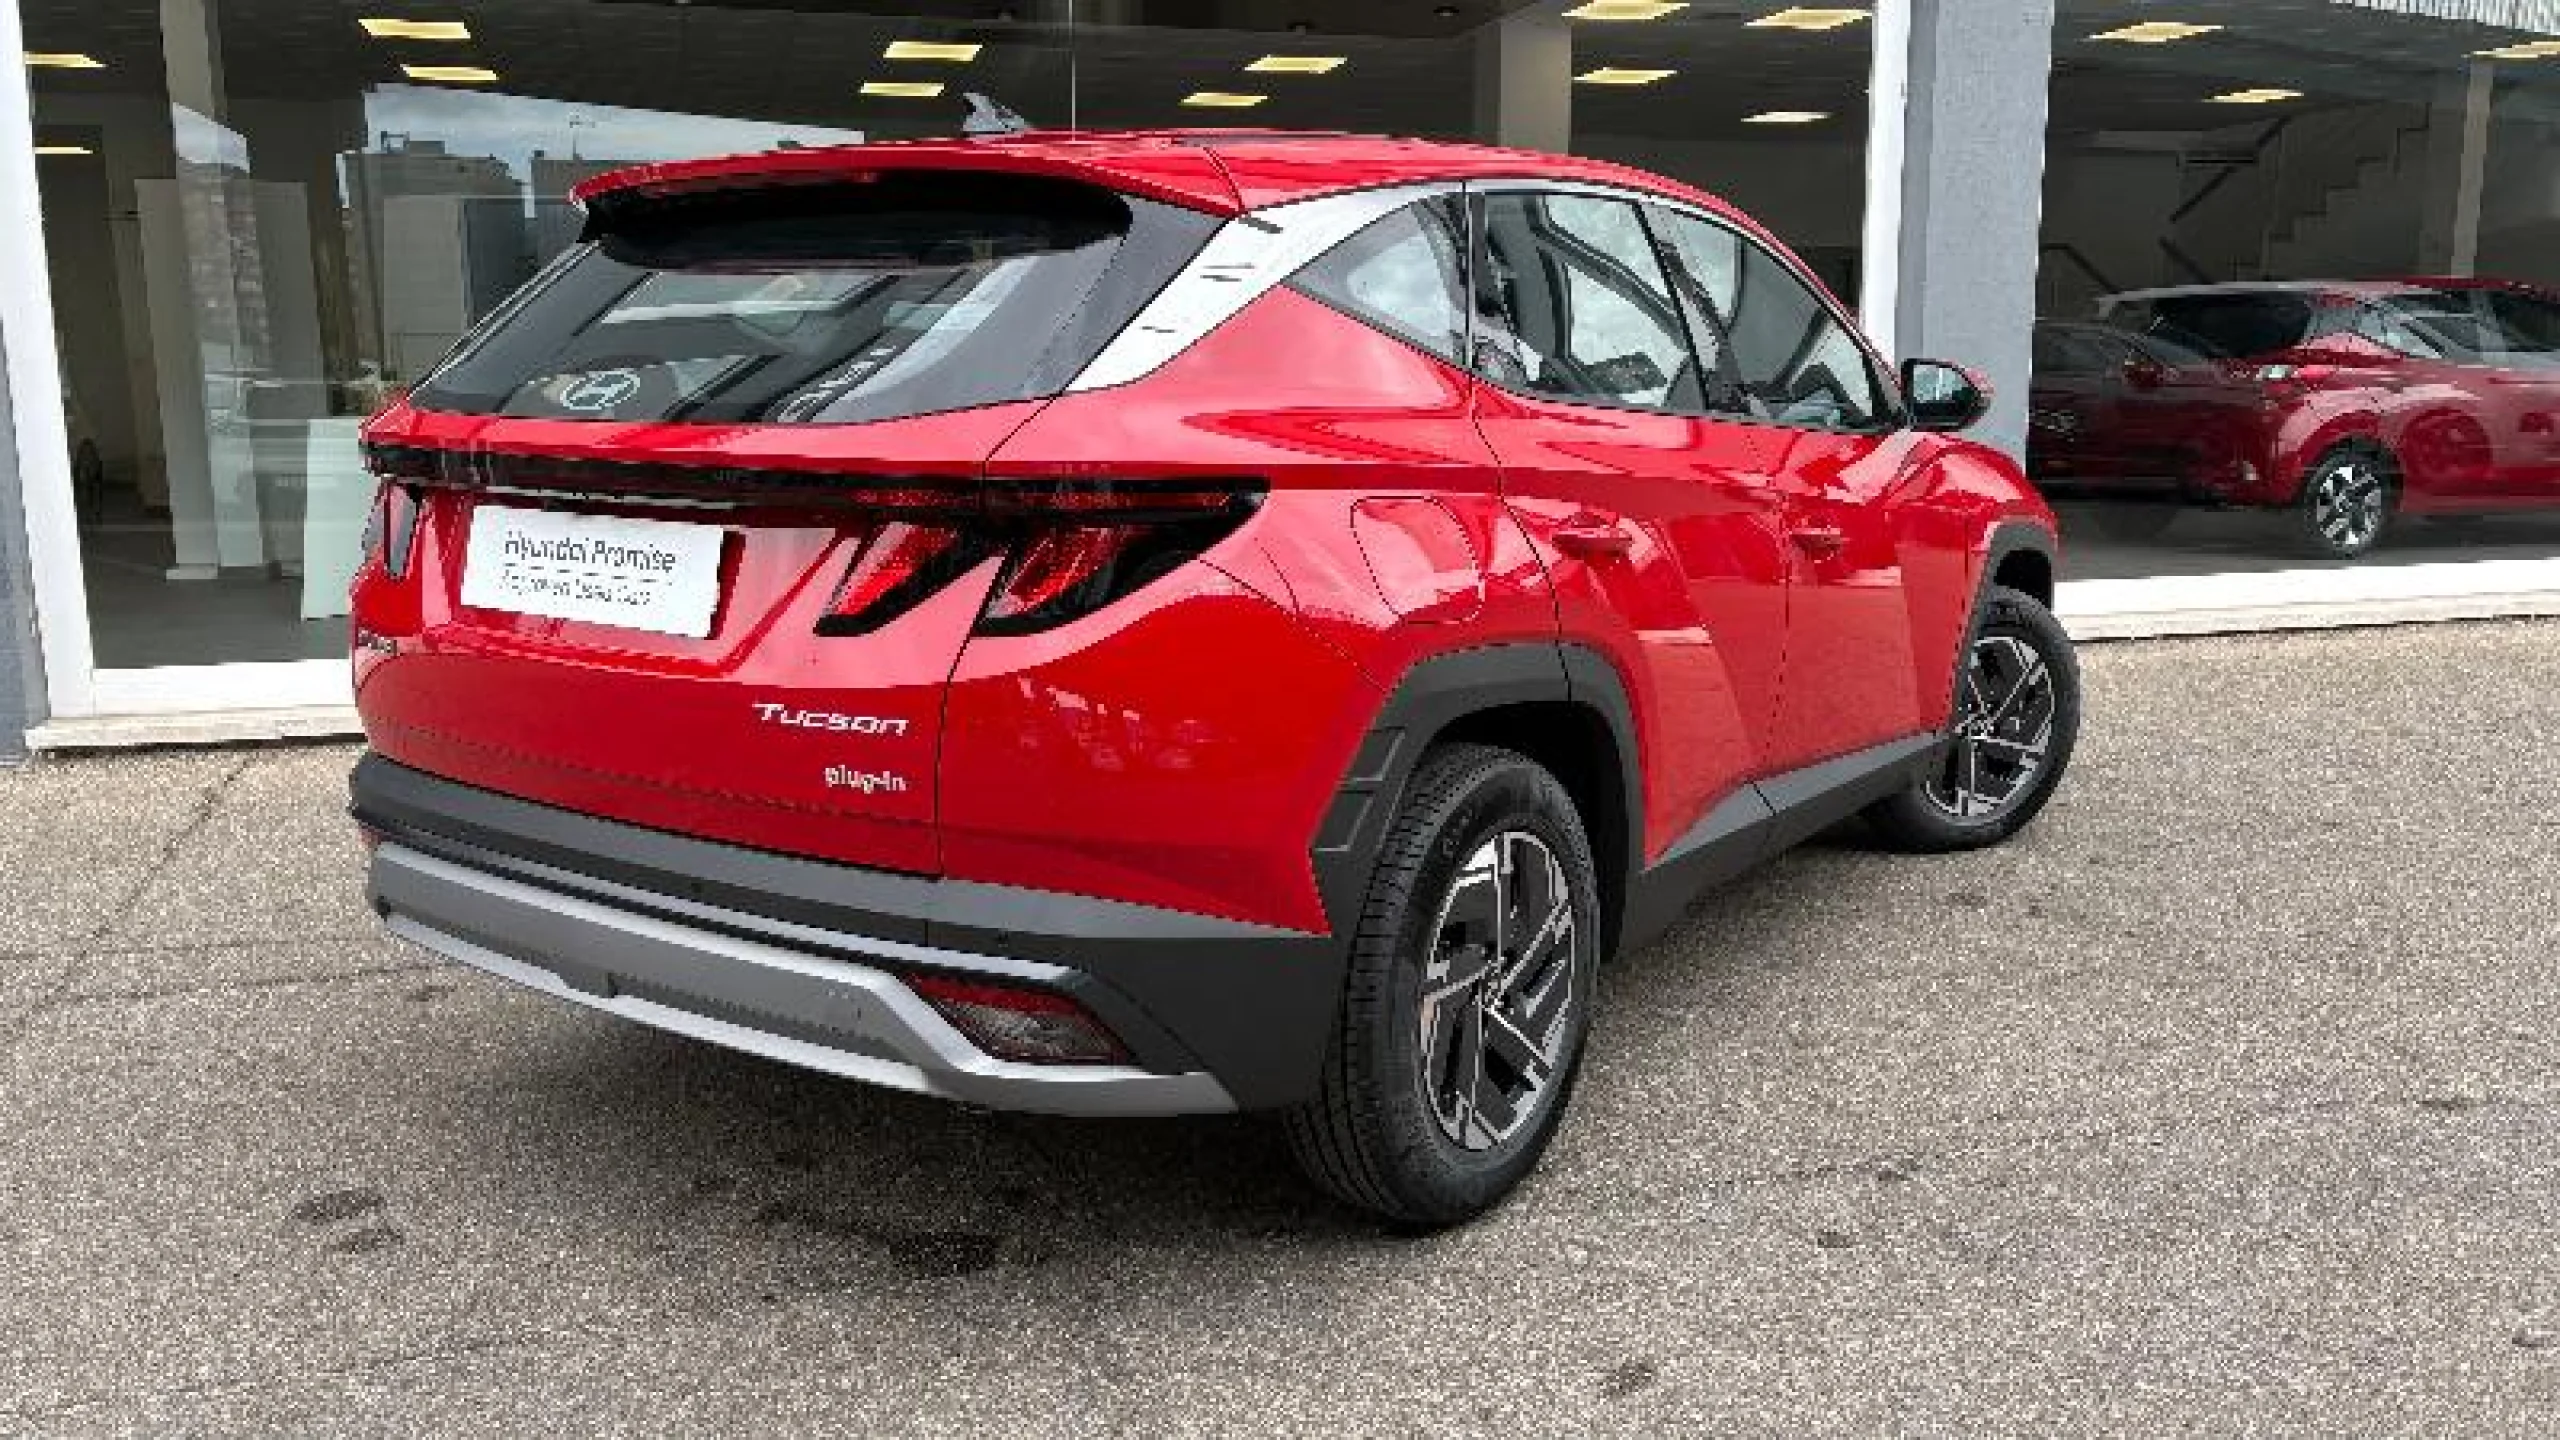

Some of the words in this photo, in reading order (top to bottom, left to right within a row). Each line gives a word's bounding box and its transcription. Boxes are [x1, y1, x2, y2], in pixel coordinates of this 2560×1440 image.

[505, 531, 589, 563] Hyundai
[592, 540, 676, 572] Promise
[825, 764, 906, 794] plug-in
